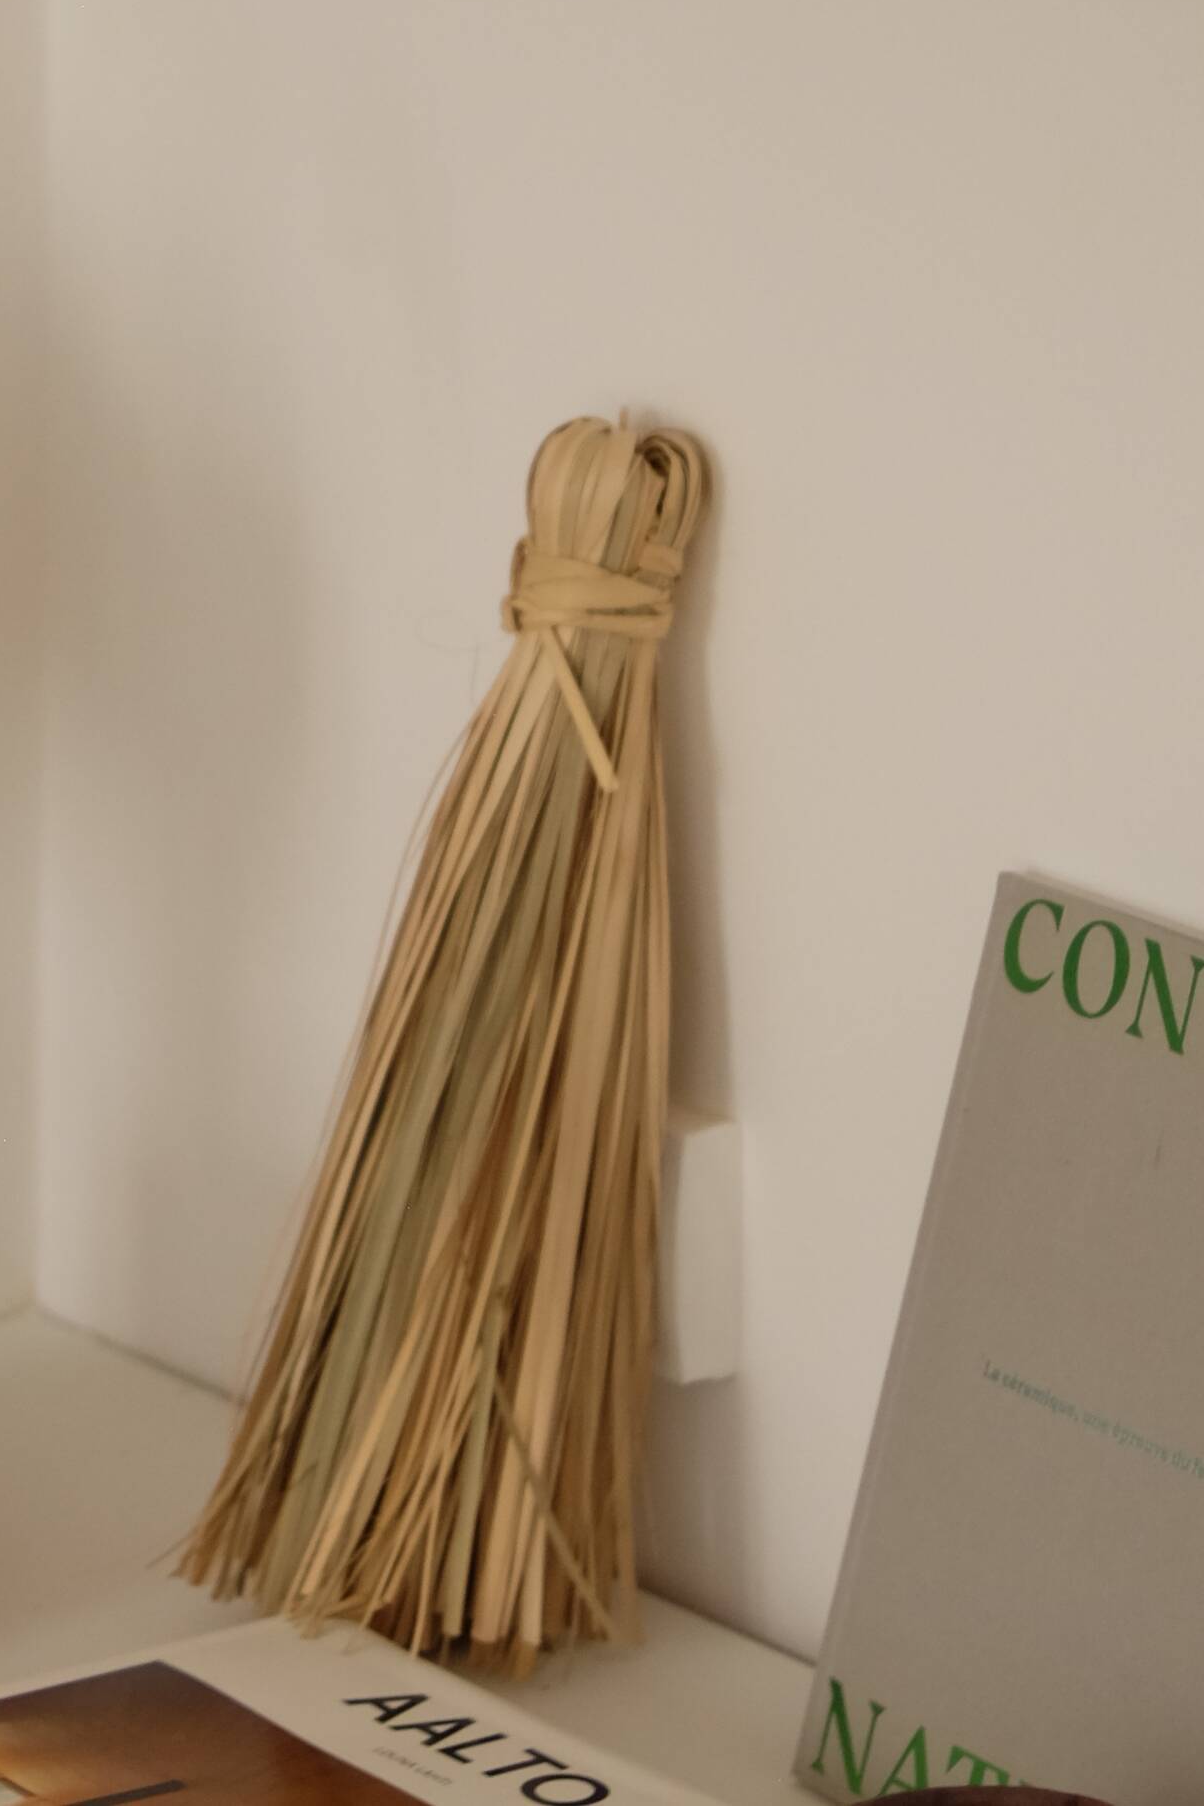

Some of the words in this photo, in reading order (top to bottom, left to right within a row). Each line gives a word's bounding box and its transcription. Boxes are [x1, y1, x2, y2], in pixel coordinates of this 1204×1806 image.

[1003, 898, 1204, 1056] CON
[343, 1694, 610, 1806] AALTO
[810, 1675, 1034, 1795] NAT
